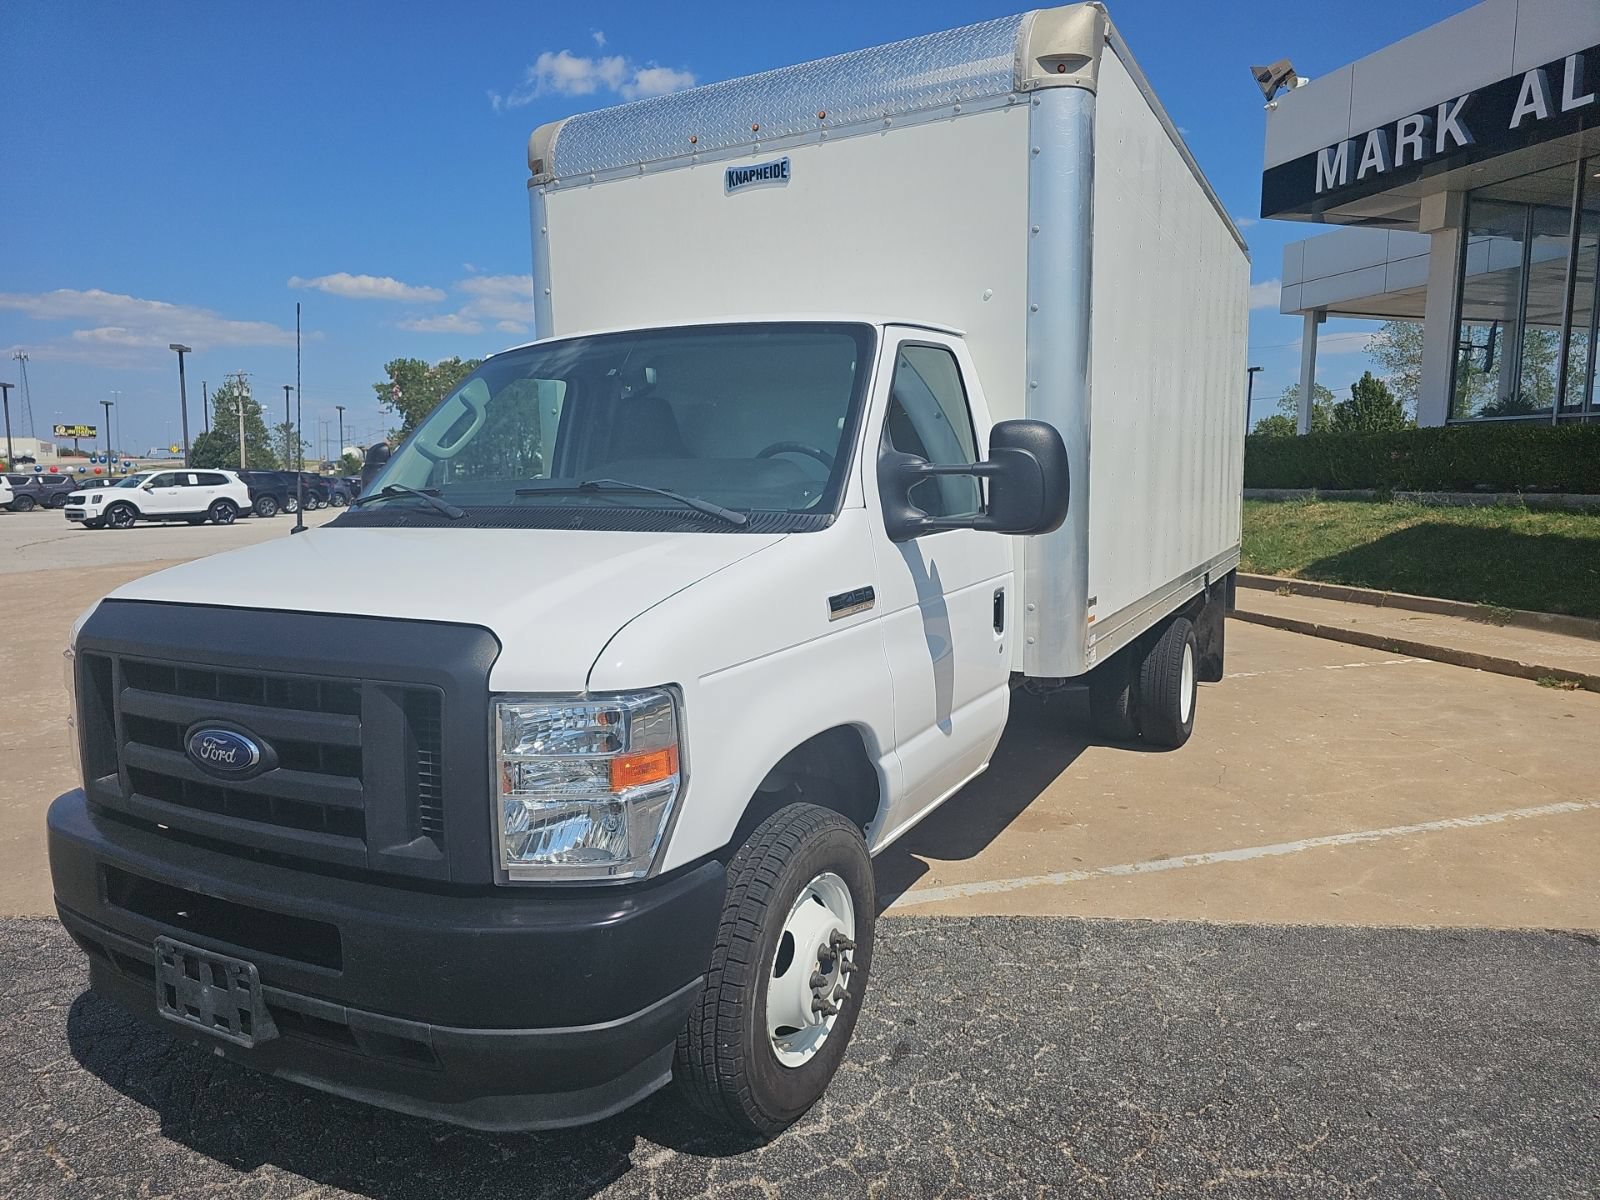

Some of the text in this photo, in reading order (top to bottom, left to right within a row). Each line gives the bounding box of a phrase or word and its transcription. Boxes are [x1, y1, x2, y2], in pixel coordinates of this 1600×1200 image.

[1314, 53, 1596, 194] MARK AL
[727, 160, 788, 188] KNAPHEIDE
[200, 736, 237, 763] Ford
